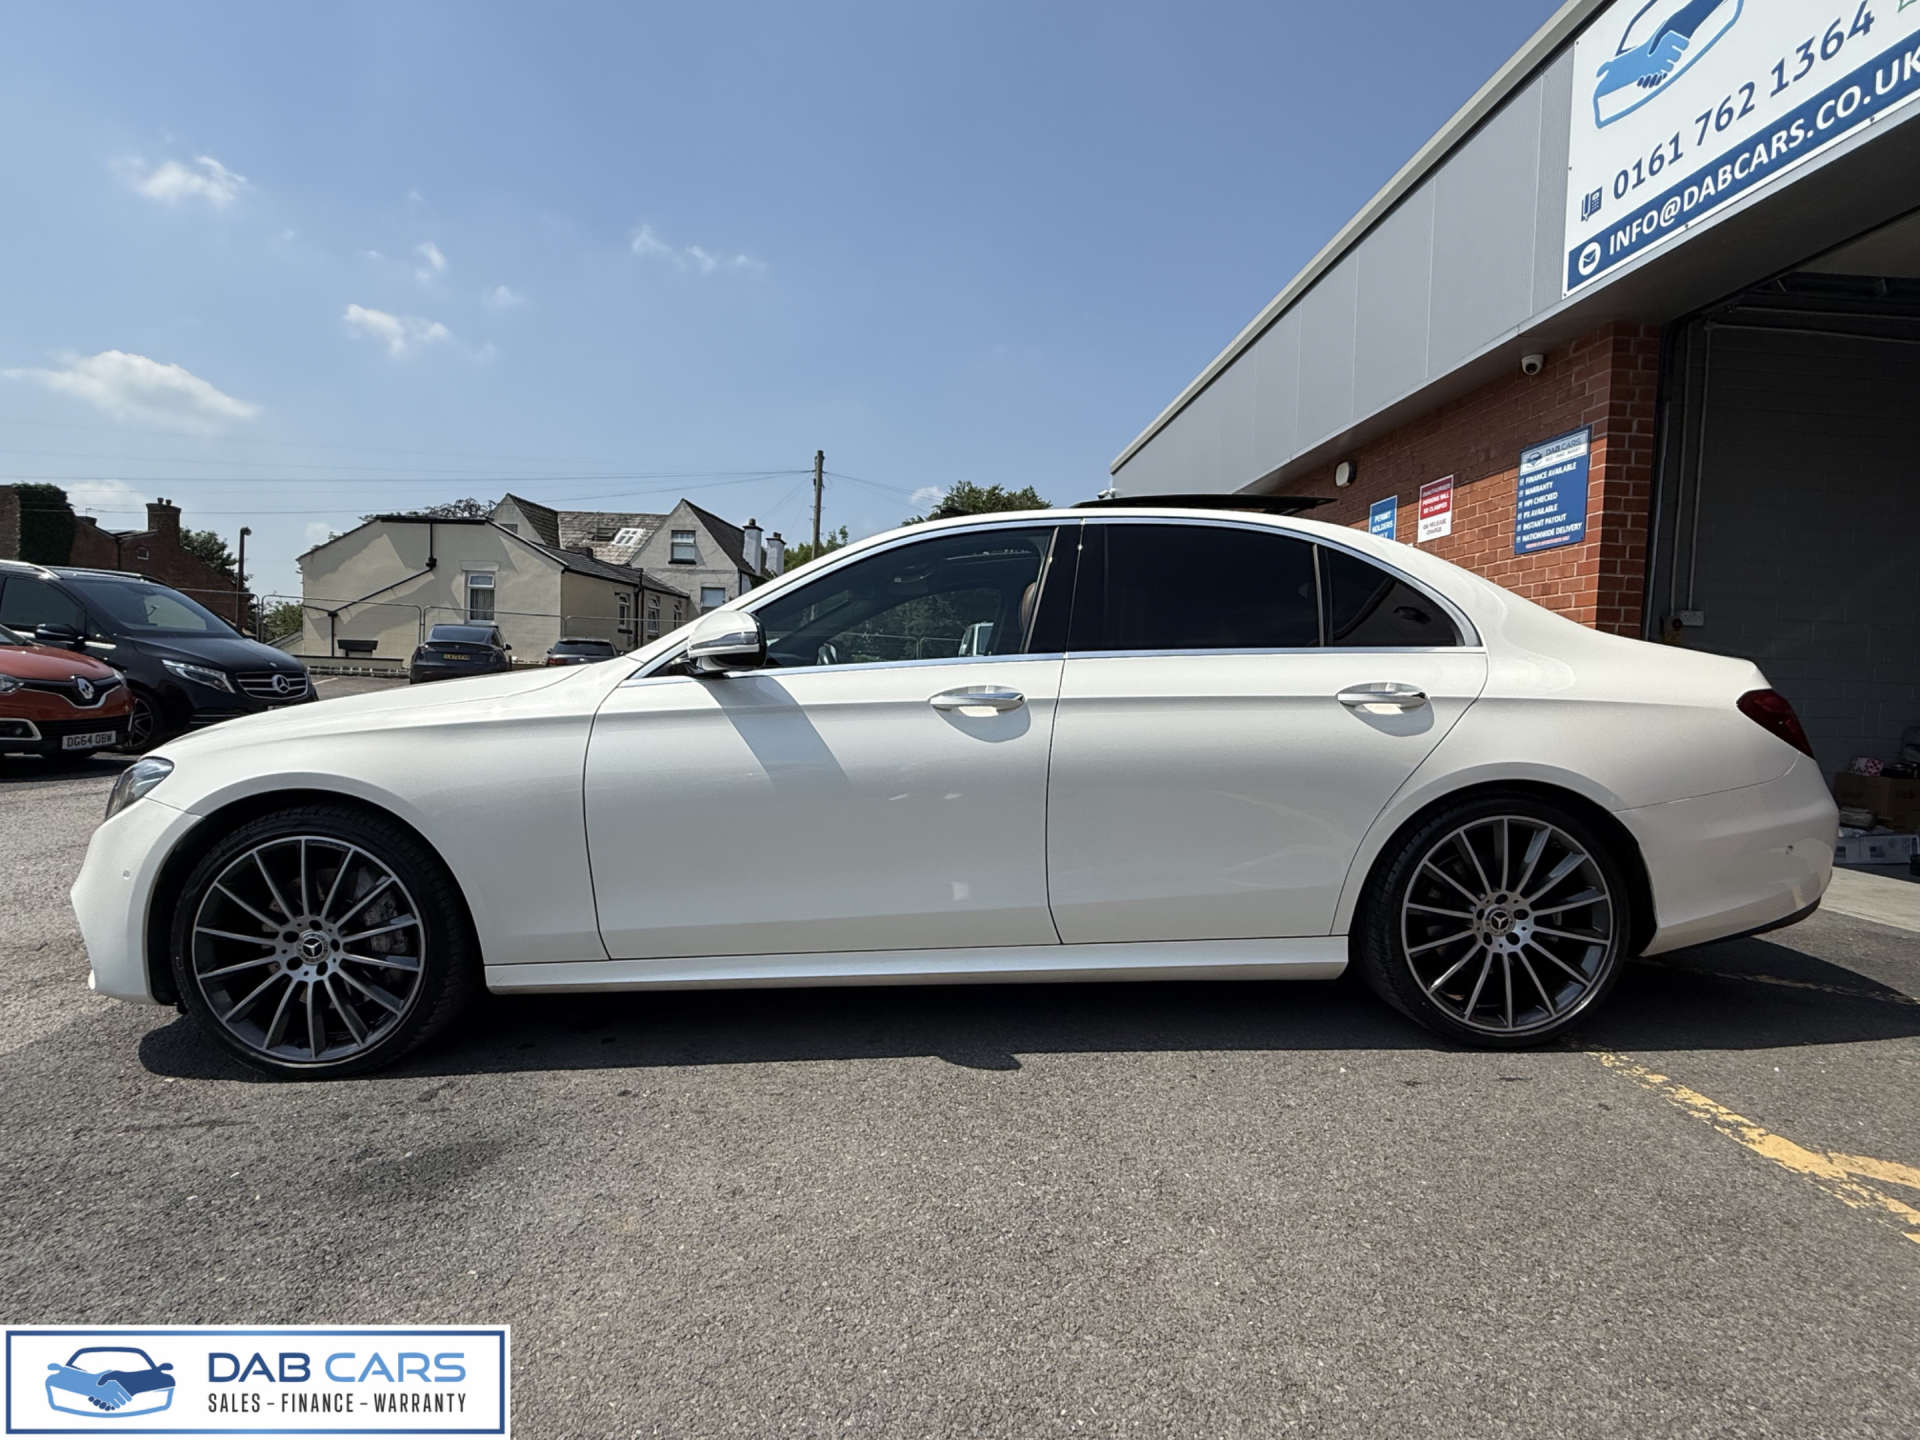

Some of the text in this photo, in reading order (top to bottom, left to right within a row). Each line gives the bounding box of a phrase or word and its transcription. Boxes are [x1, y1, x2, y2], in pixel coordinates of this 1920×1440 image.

[1613, 0, 1875, 199] 0161 762 1364
[1609, 46, 1920, 255] INFO@DABCARS.CO.UK
[1525, 461, 1577, 485] FINANCE AVAILABLE
[1525, 481, 1553, 495] WARRANTY
[1533, 491, 1559, 505] CHECKED
[1530, 503, 1558, 515] AVAILABLE
[1523, 512, 1567, 531] INSTANT PAYOUT
[1522, 528, 1555, 542] NATIONWIDE
[1555, 522, 1583, 535] DELIVERY
[66, 735, 93, 748] DG64
